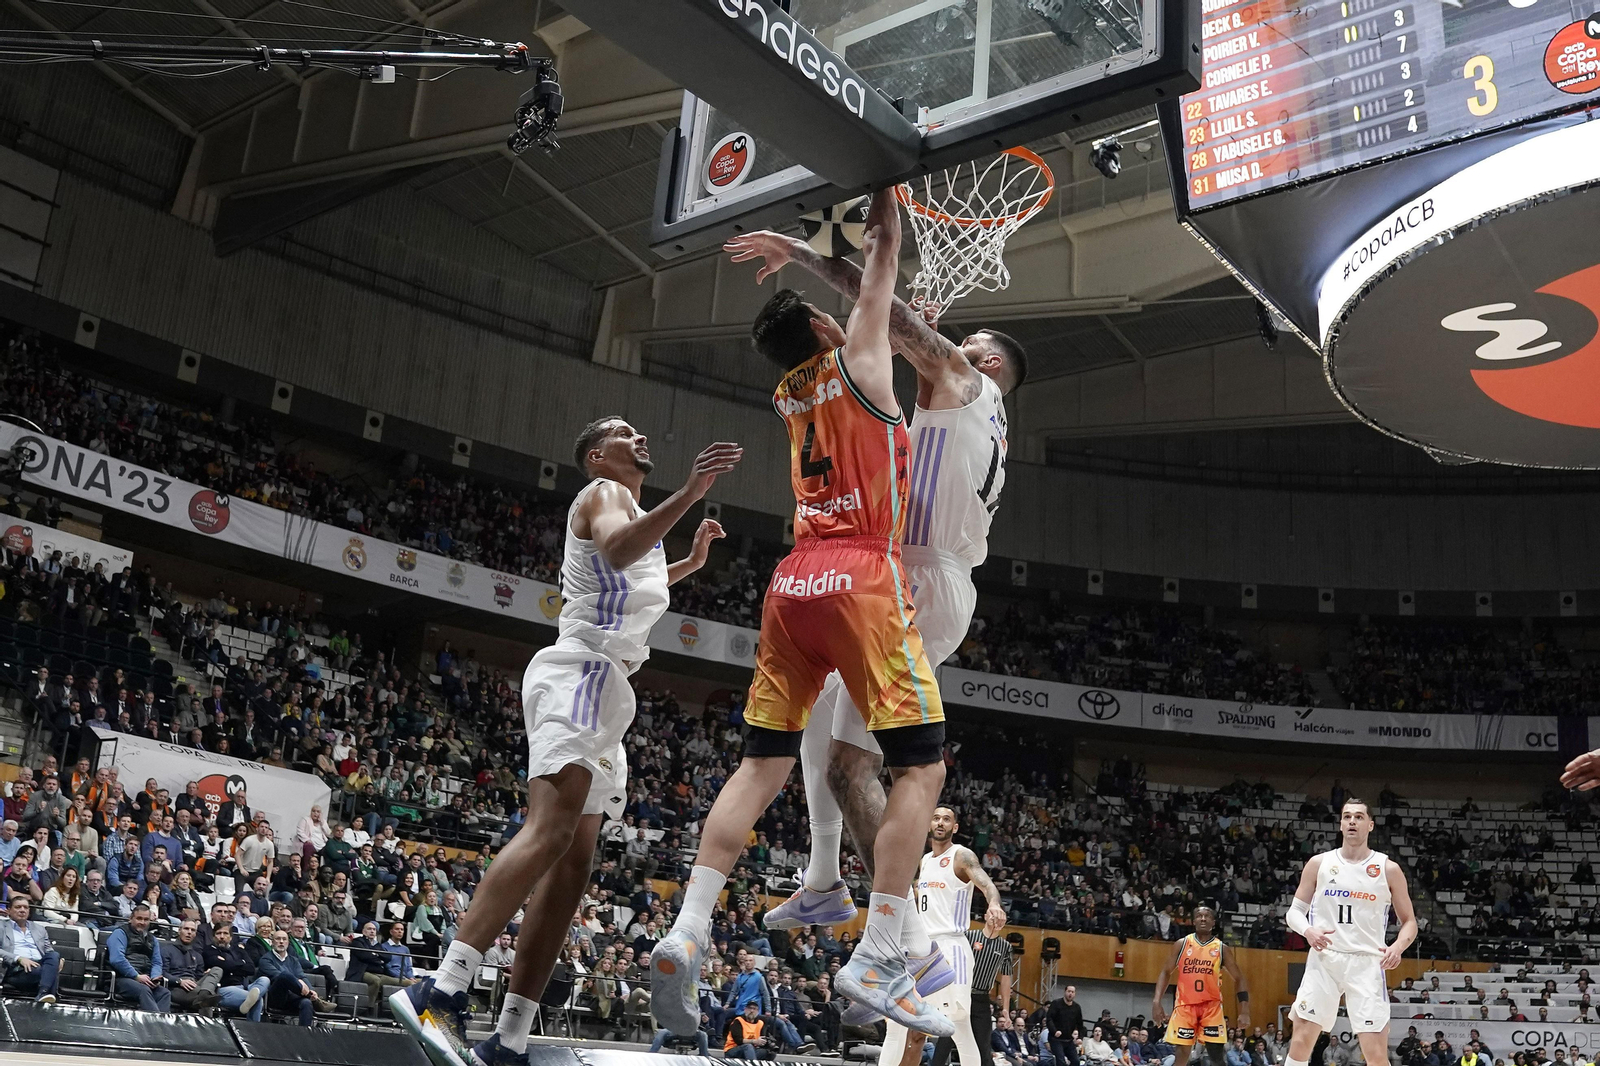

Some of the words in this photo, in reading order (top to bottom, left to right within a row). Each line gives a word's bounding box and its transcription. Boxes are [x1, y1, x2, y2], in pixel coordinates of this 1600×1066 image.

[1394, 9, 1404, 26] 3
[1202, 15, 1231, 40] DECK
[1203, 35, 1248, 64] POIRIER
[1248, 32, 1260, 48] V.
[1397, 35, 1407, 53] 7
[1564, 42, 1585, 54] acb
[717, 0, 865, 119] endesa
[1557, 47, 1597, 66] Copa
[1205, 57, 1260, 88] CORNELIE
[1261, 54, 1273, 70] P.
[1401, 62, 1411, 79] 3
[1464, 55, 1498, 116] 3
[1187, 102, 1203, 120] 22
[1208, 84, 1260, 113] TAVARES
[1260, 80, 1273, 96] E.
[1404, 89, 1414, 107] 2
[1189, 127, 1205, 145] 23
[1210, 115, 1245, 138] LLULL
[1246, 111, 1258, 127] S.
[1408, 115, 1418, 132] 4
[1192, 152, 1208, 170] 28
[1213, 132, 1272, 163] YABUSELE
[716, 158, 735, 169] Copa
[1194, 177, 1209, 195] 31
[1215, 165, 1250, 189] MUSA
[1251, 162, 1264, 177] D.
[1343, 198, 1434, 281] #CopaACB
[801, 422, 833, 487] 4
[196, 504, 217, 516] Copa
[205, 514, 218, 525] Rey
[390, 573, 419, 588] BARÇA
[491, 572, 520, 585] CAZOO
[772, 569, 852, 596] Vitaldin
[962, 681, 1048, 708] endesa
[1152, 703, 1193, 718] divina
[1218, 711, 1276, 729] SPALDING
[1293, 721, 1334, 734] Halcón
[1379, 726, 1432, 738] MONDO
[159, 743, 206, 759] COPA
[238, 760, 266, 771] REY
[205, 793, 221, 802] acb
[921, 894, 928, 912] 8
[1324, 889, 1376, 901] AUTOHERO
[1337, 904, 1353, 924] 11
[1183, 966, 1213, 975] Esfuerz
[1184, 957, 1211, 967] Cultura
[1194, 979, 1204, 992] 0
[1511, 1030, 1568, 1047] COPA
